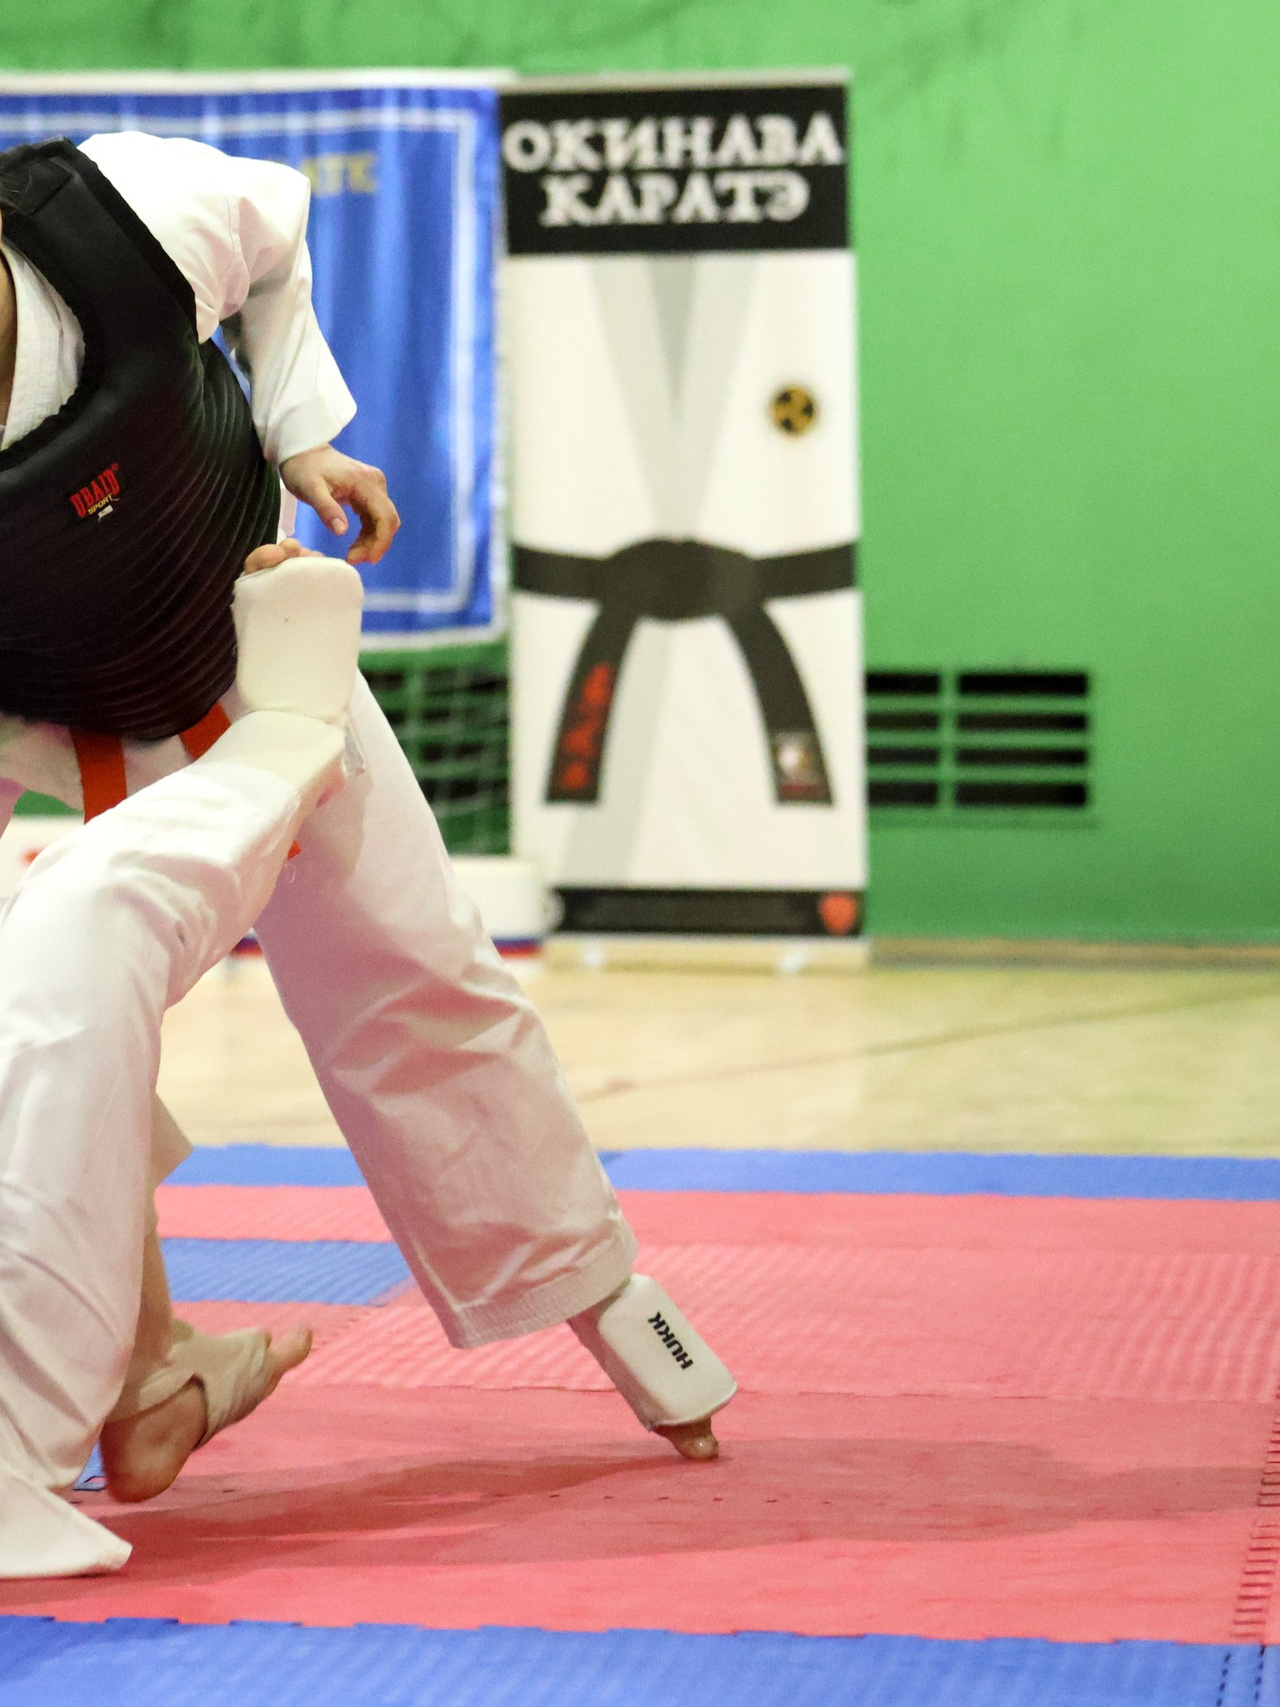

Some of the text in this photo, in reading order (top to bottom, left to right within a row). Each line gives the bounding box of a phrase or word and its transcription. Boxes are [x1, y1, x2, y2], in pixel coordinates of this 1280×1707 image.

[502, 113, 843, 172] ОКИНАВА
[540, 168, 810, 226] КАРАТЭ
[87, 493, 113, 515] SPORT
[647, 1311, 694, 1370] HUKK
